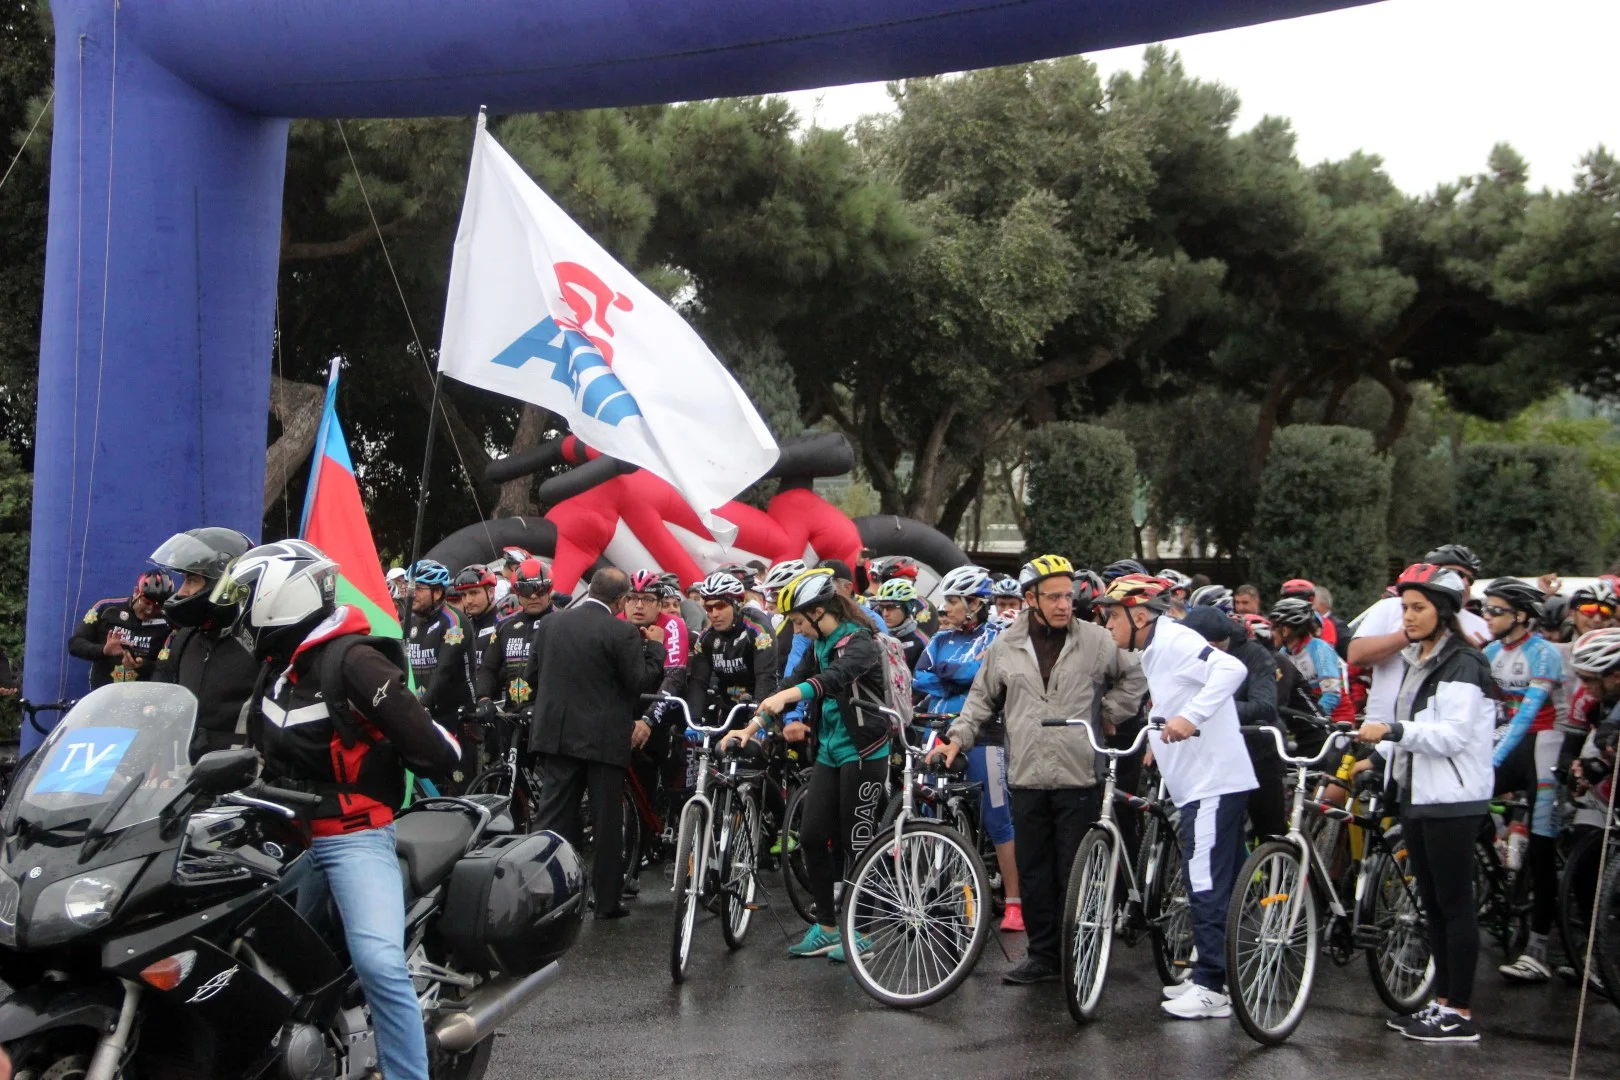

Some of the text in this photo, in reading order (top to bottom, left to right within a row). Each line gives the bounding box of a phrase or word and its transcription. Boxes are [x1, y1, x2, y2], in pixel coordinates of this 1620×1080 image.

[506, 642, 530, 651] SECUR
[665, 619, 680, 663] BAKU
[60, 743, 117, 774] TV
[686, 747, 694, 788] BAKU
